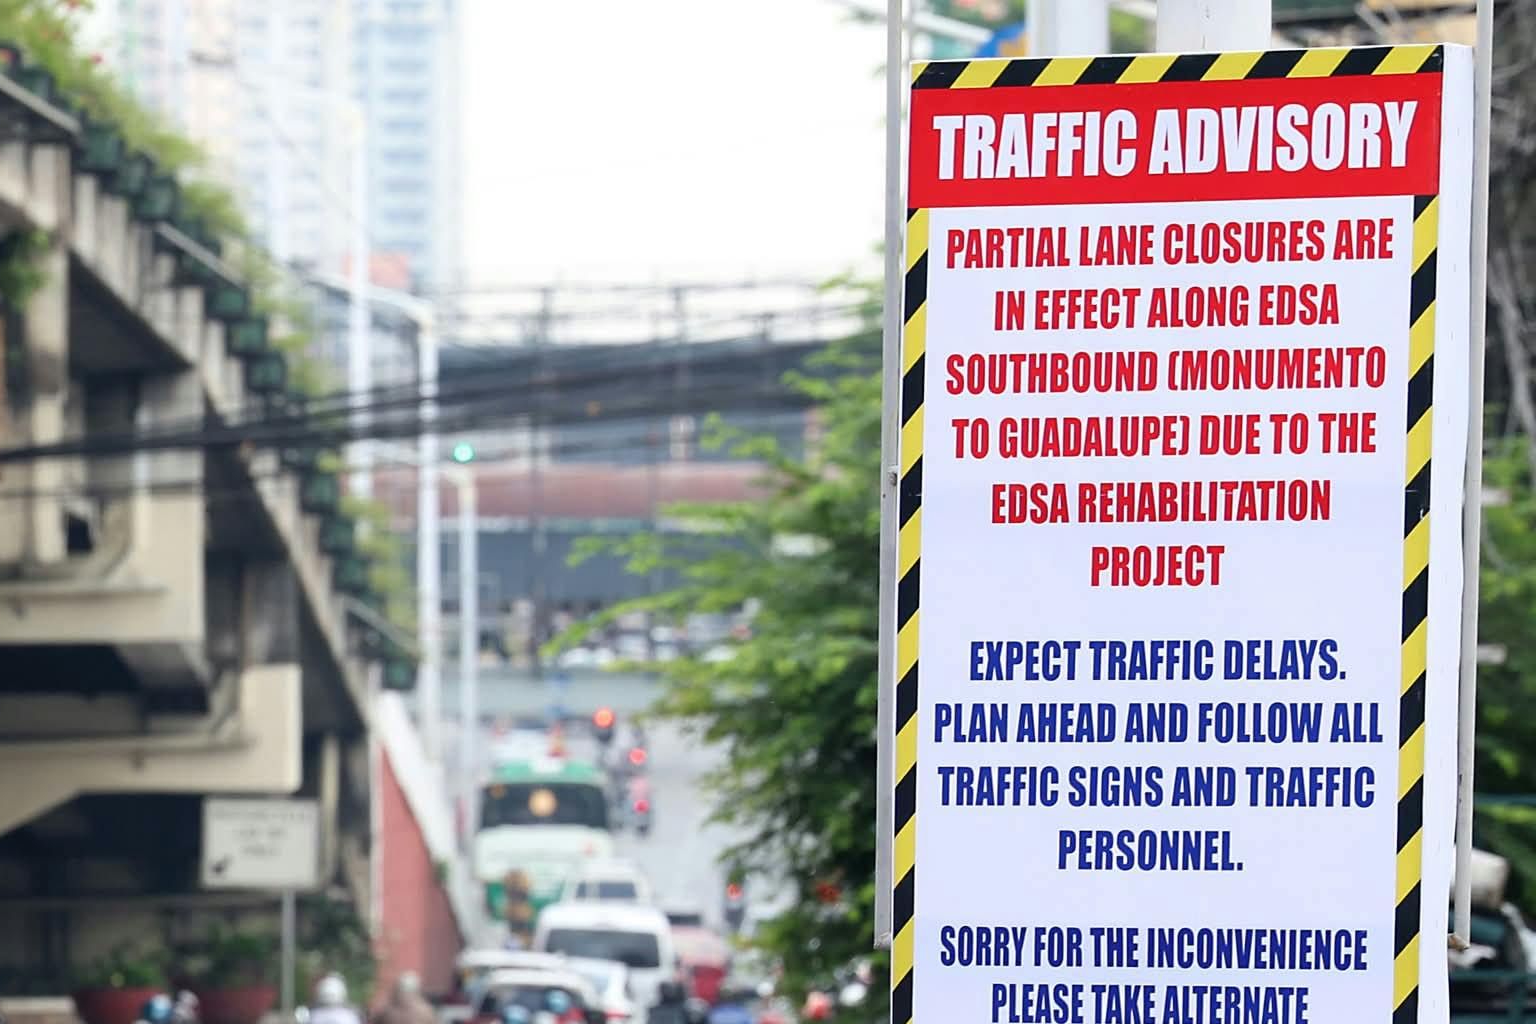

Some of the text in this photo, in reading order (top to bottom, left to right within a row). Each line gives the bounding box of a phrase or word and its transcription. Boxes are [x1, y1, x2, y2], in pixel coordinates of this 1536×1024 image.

[933, 100, 1418, 180] TRAFFIC ADVISORY
[946, 217, 1394, 270] PARTIAL LANE CLOSURES ARE
[994, 283, 1340, 331] IN EFFECT ALONG EDSA
[945, 345, 1386, 396] SOUTHBOUND (MONUMENTO
[951, 412, 1377, 459] TO GUADALUPE) DUE TO THE
[991, 479, 1331, 525] EDSA REHABILITATION
[1091, 544, 1225, 588] PROJECT
[969, 638, 1346, 682] EXPECT TRAFFIC DELAYS.
[934, 701, 1383, 744] PLAN AHEAD AND FOLLOW ALL
[937, 765, 1375, 809] TRAFFIC SIGNS AND TRAFFIC
[1058, 829, 1244, 872] PERSONNEL.
[940, 925, 1368, 971] SORRY FOR THE INCONVENIENCE
[991, 983, 1084, 1024] PLEASE
